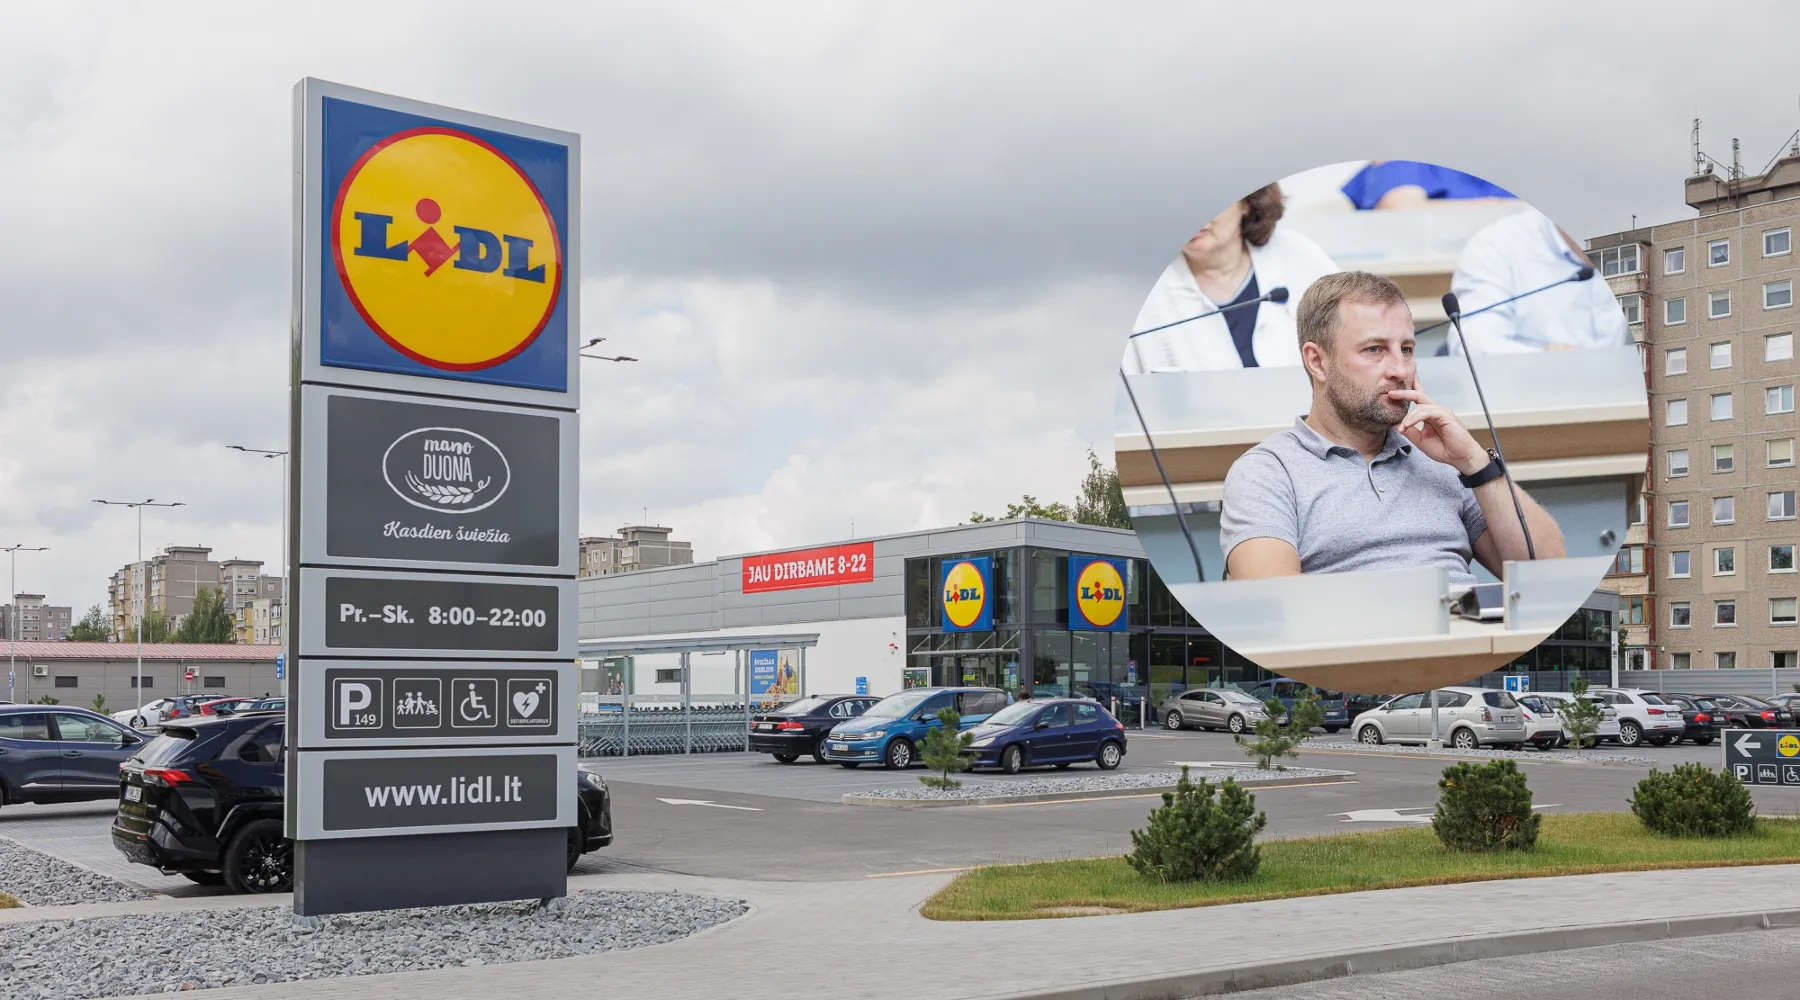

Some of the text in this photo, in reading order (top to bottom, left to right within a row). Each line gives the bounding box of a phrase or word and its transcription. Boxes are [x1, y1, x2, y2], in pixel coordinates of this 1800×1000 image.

[424, 439, 474, 455] mano
[423, 454, 473, 482] DUONA
[383, 521, 511, 543] Kasdien šviežia
[748, 553, 867, 583] JAU DIRBAME 8-22
[340, 682, 373, 725] P
[354, 714, 376, 726] 149
[1736, 765, 1748, 780] P
[364, 775, 522, 808] www.lidl.lt
